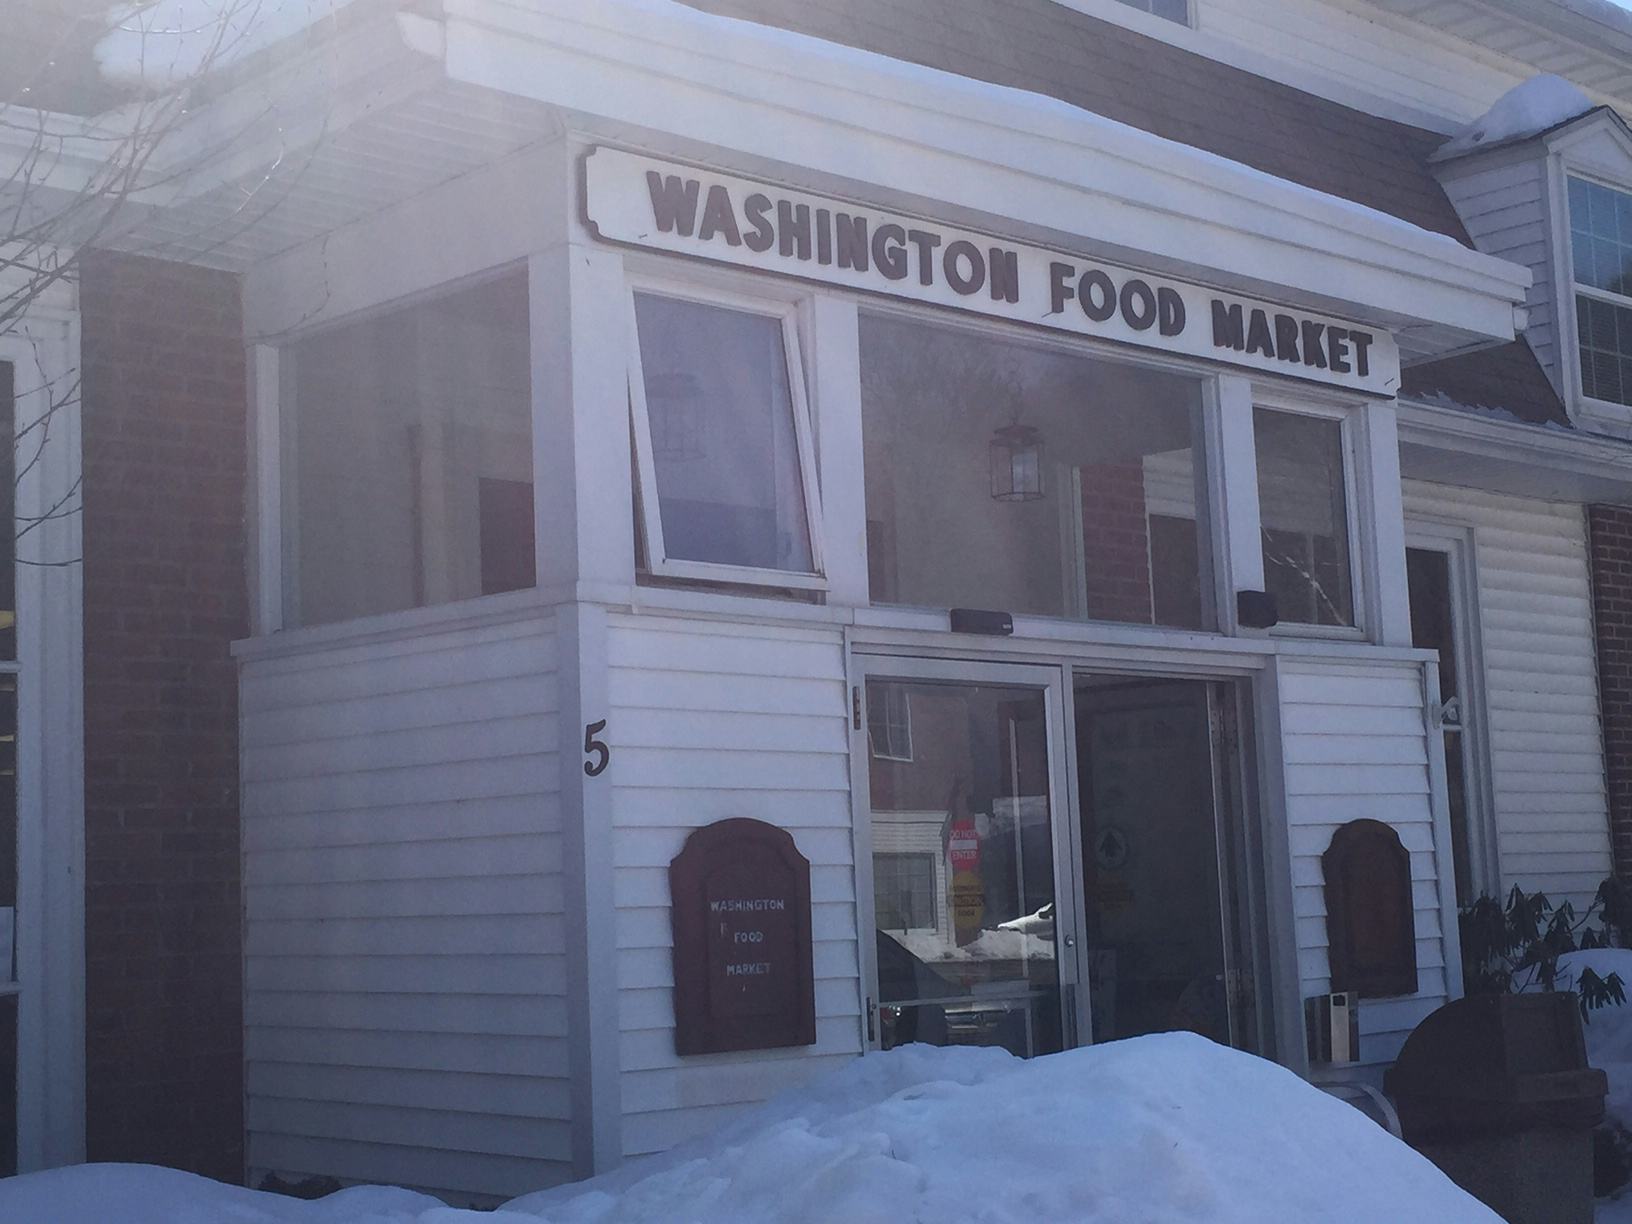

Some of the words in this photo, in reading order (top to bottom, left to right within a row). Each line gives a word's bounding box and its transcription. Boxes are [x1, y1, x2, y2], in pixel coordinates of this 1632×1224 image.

[646, 170, 1019, 304] WASHINGTON
[1049, 261, 1187, 337] FOOD
[1210, 299, 1374, 378] MARKET
[584, 718, 610, 777] 5
[949, 829, 960, 839] DO
[961, 829, 977, 839] NOT
[951, 850, 977, 860] ENTER
[710, 899, 785, 912] WASHINGTON
[734, 931, 763, 943] FOOD
[727, 963, 772, 977] MARKET
